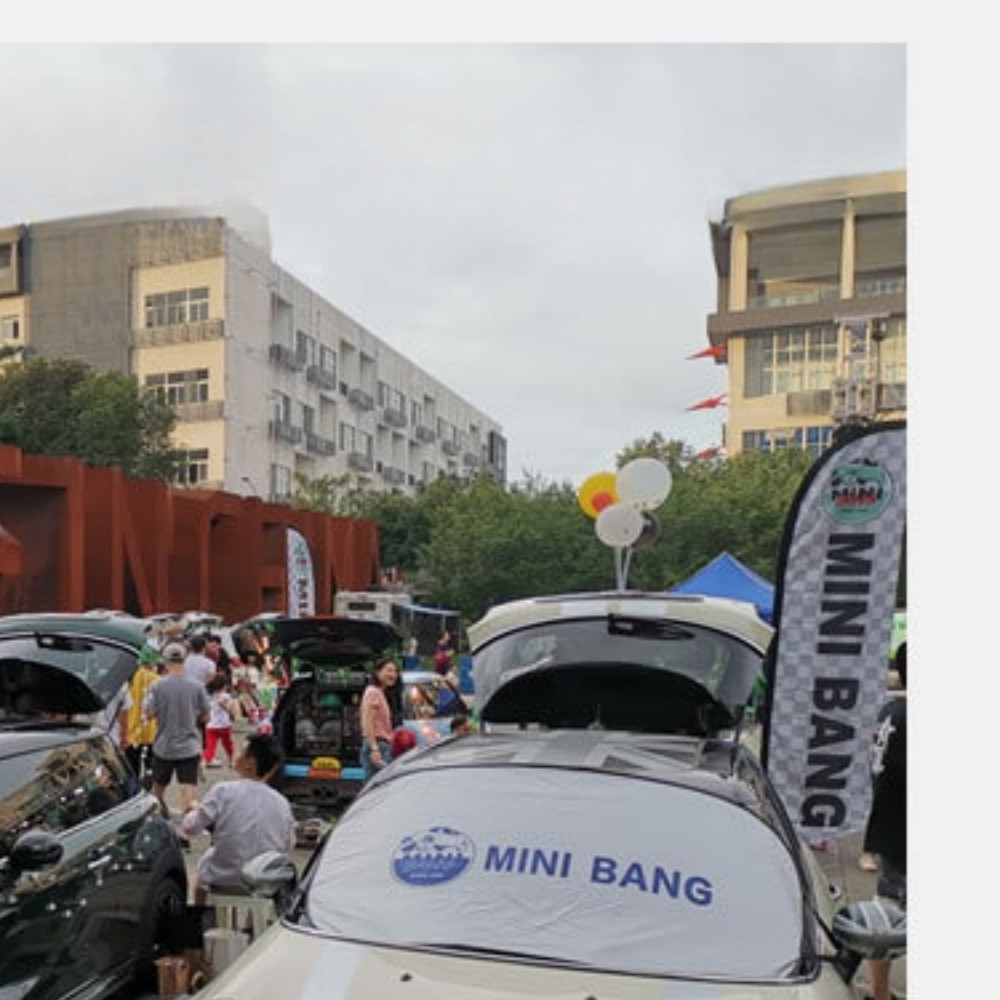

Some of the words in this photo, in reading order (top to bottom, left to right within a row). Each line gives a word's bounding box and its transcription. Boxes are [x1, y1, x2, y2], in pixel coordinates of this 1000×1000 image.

[817, 532, 876, 656] MINI
[801, 676, 859, 829] BANG
[484, 845, 572, 878] MINI
[590, 855, 714, 907] BANG
